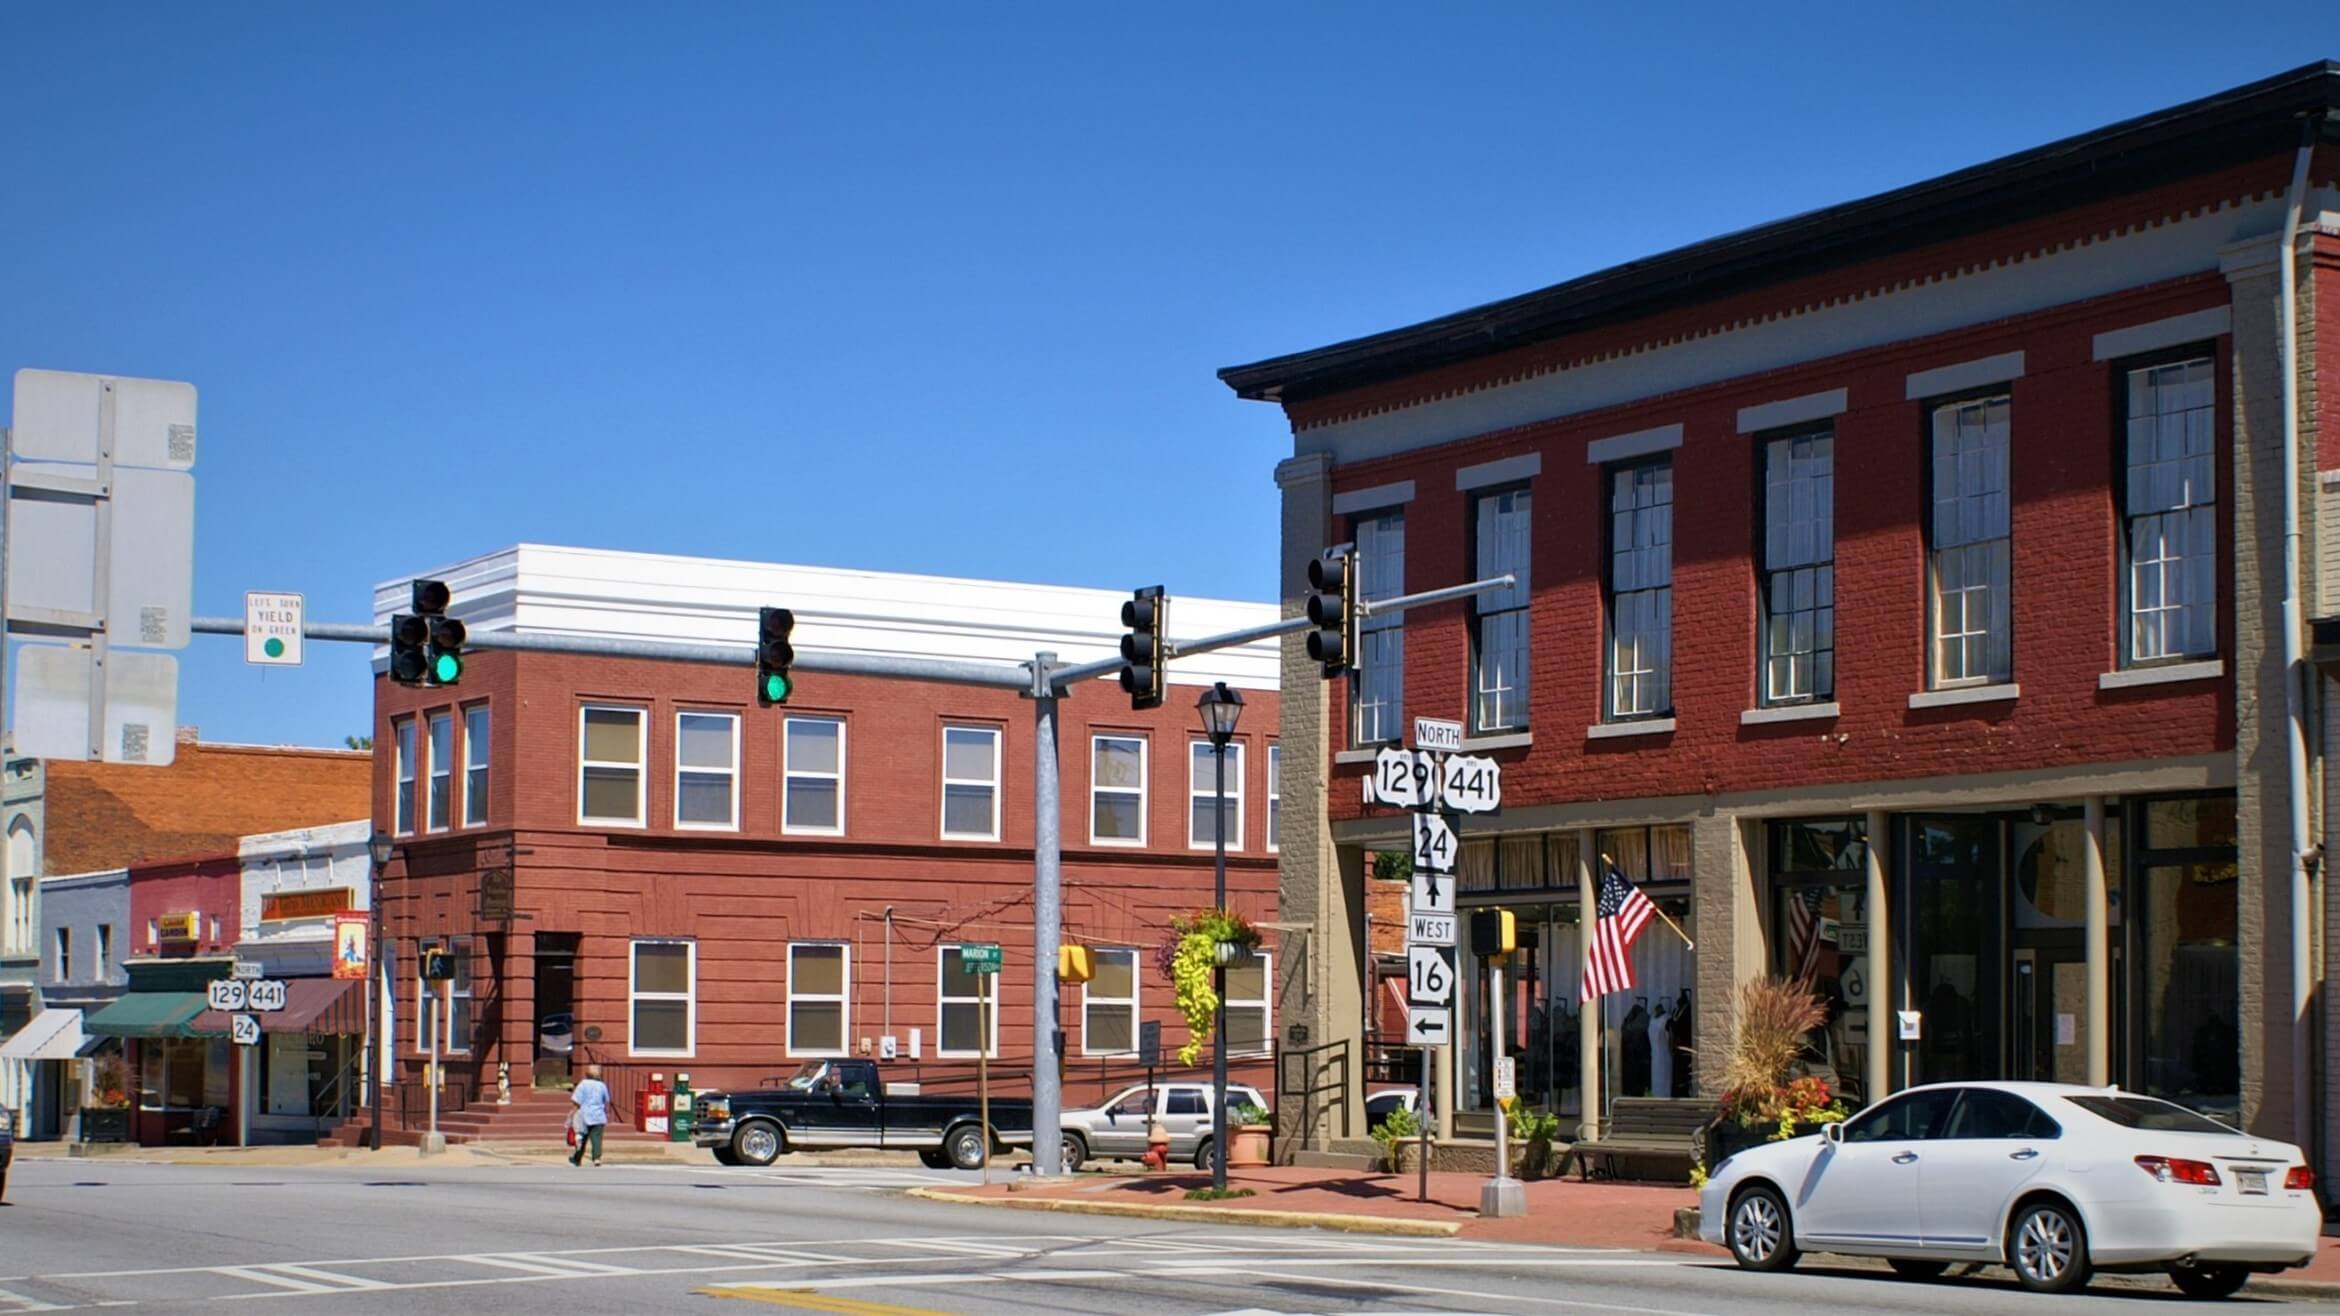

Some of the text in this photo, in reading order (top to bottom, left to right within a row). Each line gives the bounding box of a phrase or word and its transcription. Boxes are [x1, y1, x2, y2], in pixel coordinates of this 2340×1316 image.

[249, 598, 300, 608] LEFT TURN
[258, 610, 293, 623] YIELD
[251, 625, 297, 635] ON GREEN
[1418, 722, 1460, 745] NORTH
[1382, 760, 1429, 793] 129
[1448, 767, 1494, 800] 441
[1418, 826, 1448, 860] 24
[1415, 918, 1451, 938] WEST
[235, 965, 261, 975] NORTH
[1416, 960, 1443, 992] 16
[213, 986, 242, 1003] 129
[253, 987, 281, 1003] 441
[236, 1022, 253, 1038] 24
